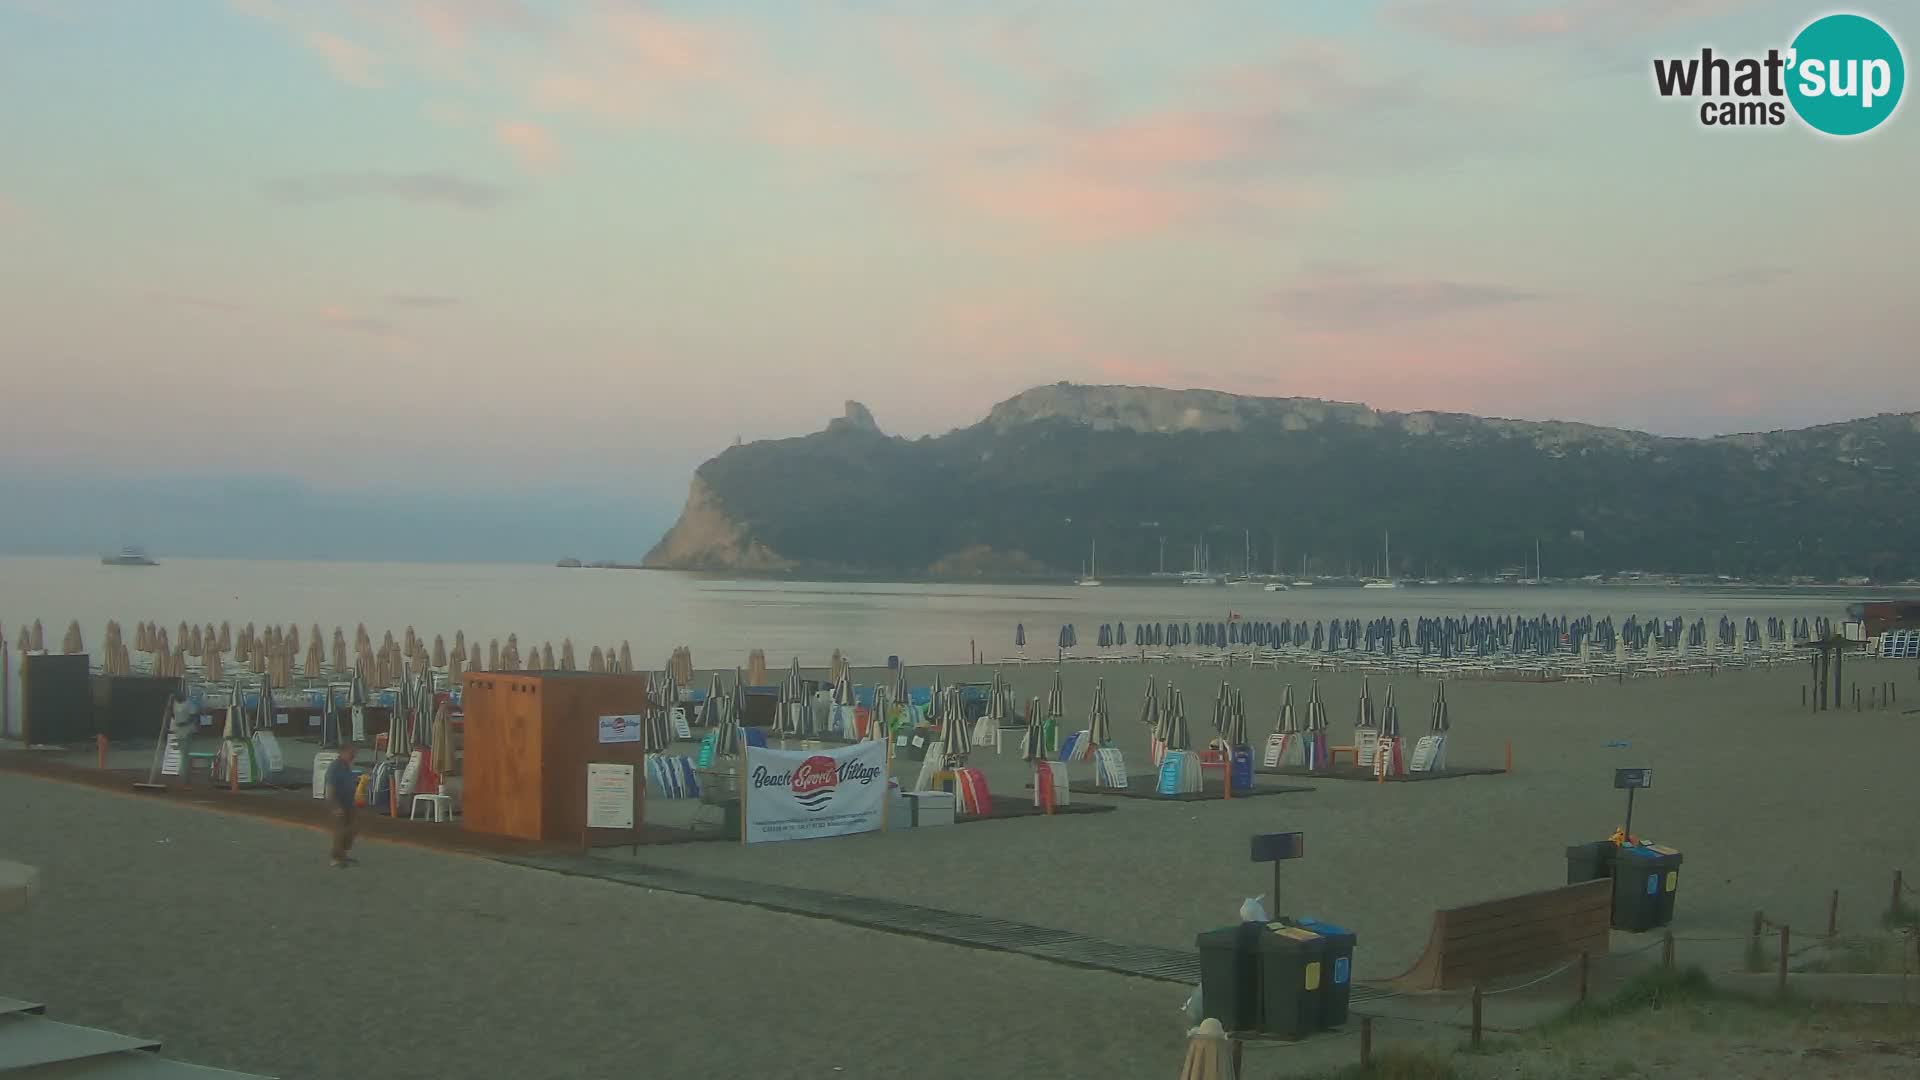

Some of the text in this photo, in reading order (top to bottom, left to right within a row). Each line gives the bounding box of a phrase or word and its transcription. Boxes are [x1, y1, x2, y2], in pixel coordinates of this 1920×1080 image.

[752, 758, 881, 789] Beach Sport Village
